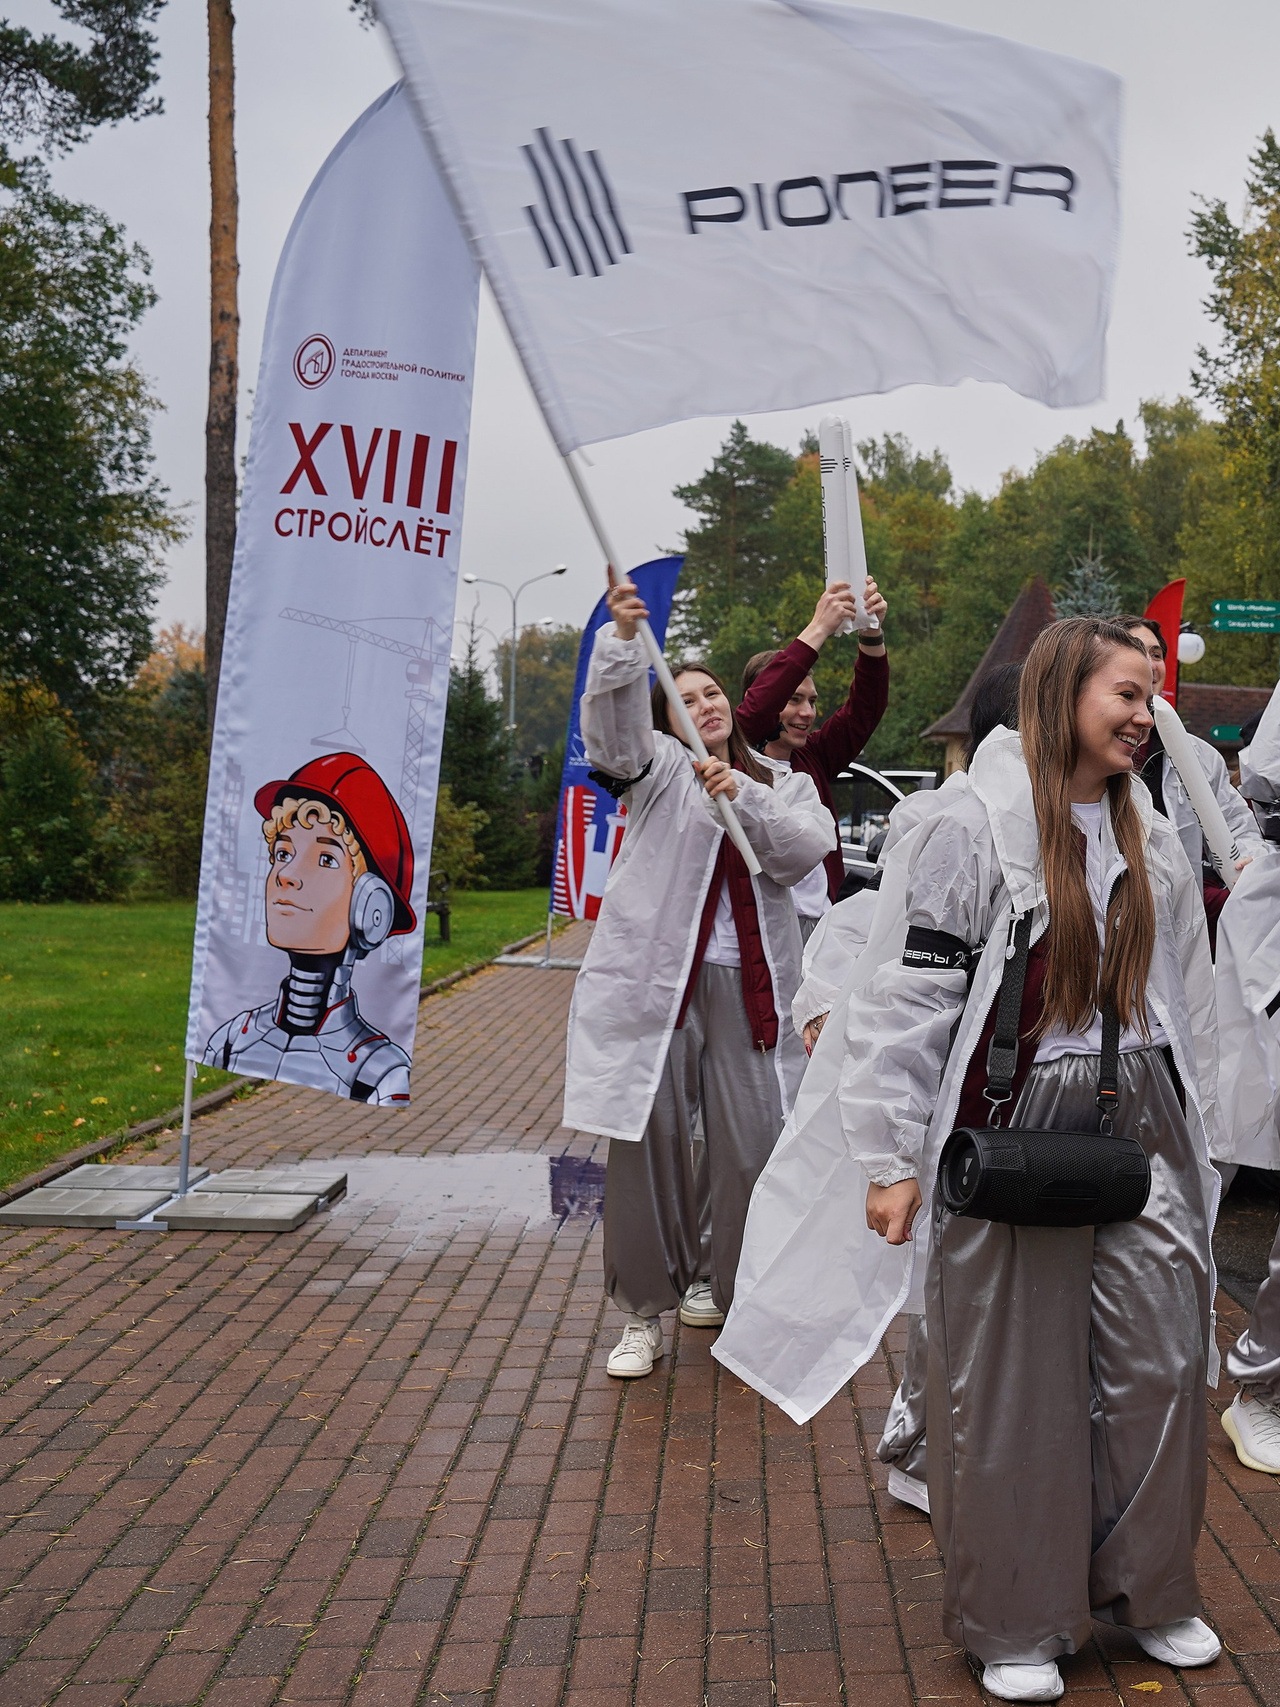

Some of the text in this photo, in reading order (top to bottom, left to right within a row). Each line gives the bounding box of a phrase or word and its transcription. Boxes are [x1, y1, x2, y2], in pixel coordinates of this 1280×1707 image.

[678, 159, 1078, 236] PIONEER
[341, 358, 466, 382] ГРАДОСТРОИТЕЛЬНОЙ ПОЛИТИКИ
[342, 348, 388, 358] ДЕПАРТАМЕНТ
[340, 369, 399, 381] ГОРОДА МОСКВЫ
[279, 422, 458, 515] XVIII
[274, 506, 452, 558] СТРОЙСЛЁТ
